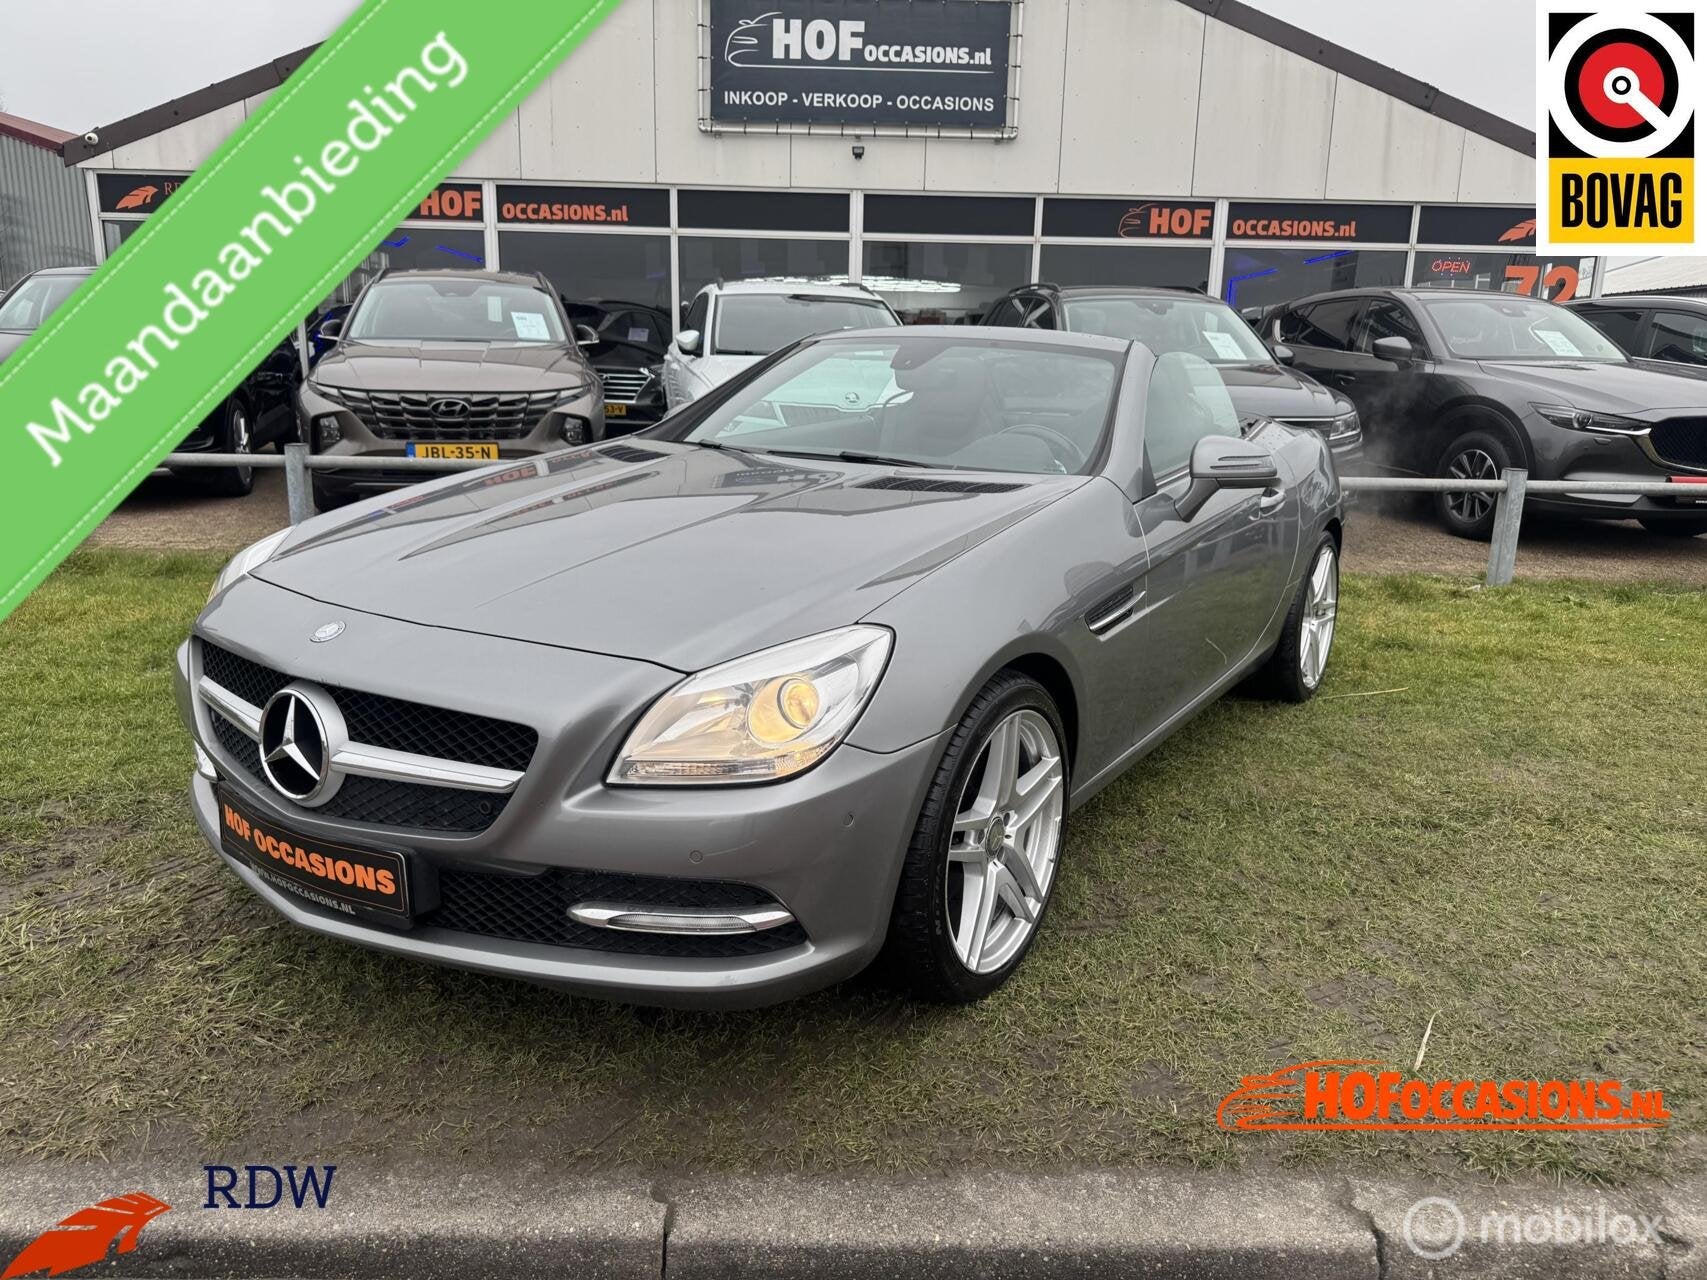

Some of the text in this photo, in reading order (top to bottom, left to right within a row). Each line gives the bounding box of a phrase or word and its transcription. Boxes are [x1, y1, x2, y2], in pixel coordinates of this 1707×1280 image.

[724, 91, 788, 106] INKOOP
[802, 92, 882, 109] VERKOOP
[896, 95, 994, 112] OCCASIONS
[420, 190, 628, 222] HOF OCCASIONS.nl
[1150, 208, 1356, 237] HOF OCCASIONS.nl
[1431, 259, 1471, 273] OPEN
[1504, 265, 1579, 303] 72
[422, 446, 491, 460] JBL-35-N
[223, 803, 396, 895] HOF OCCASIONS
